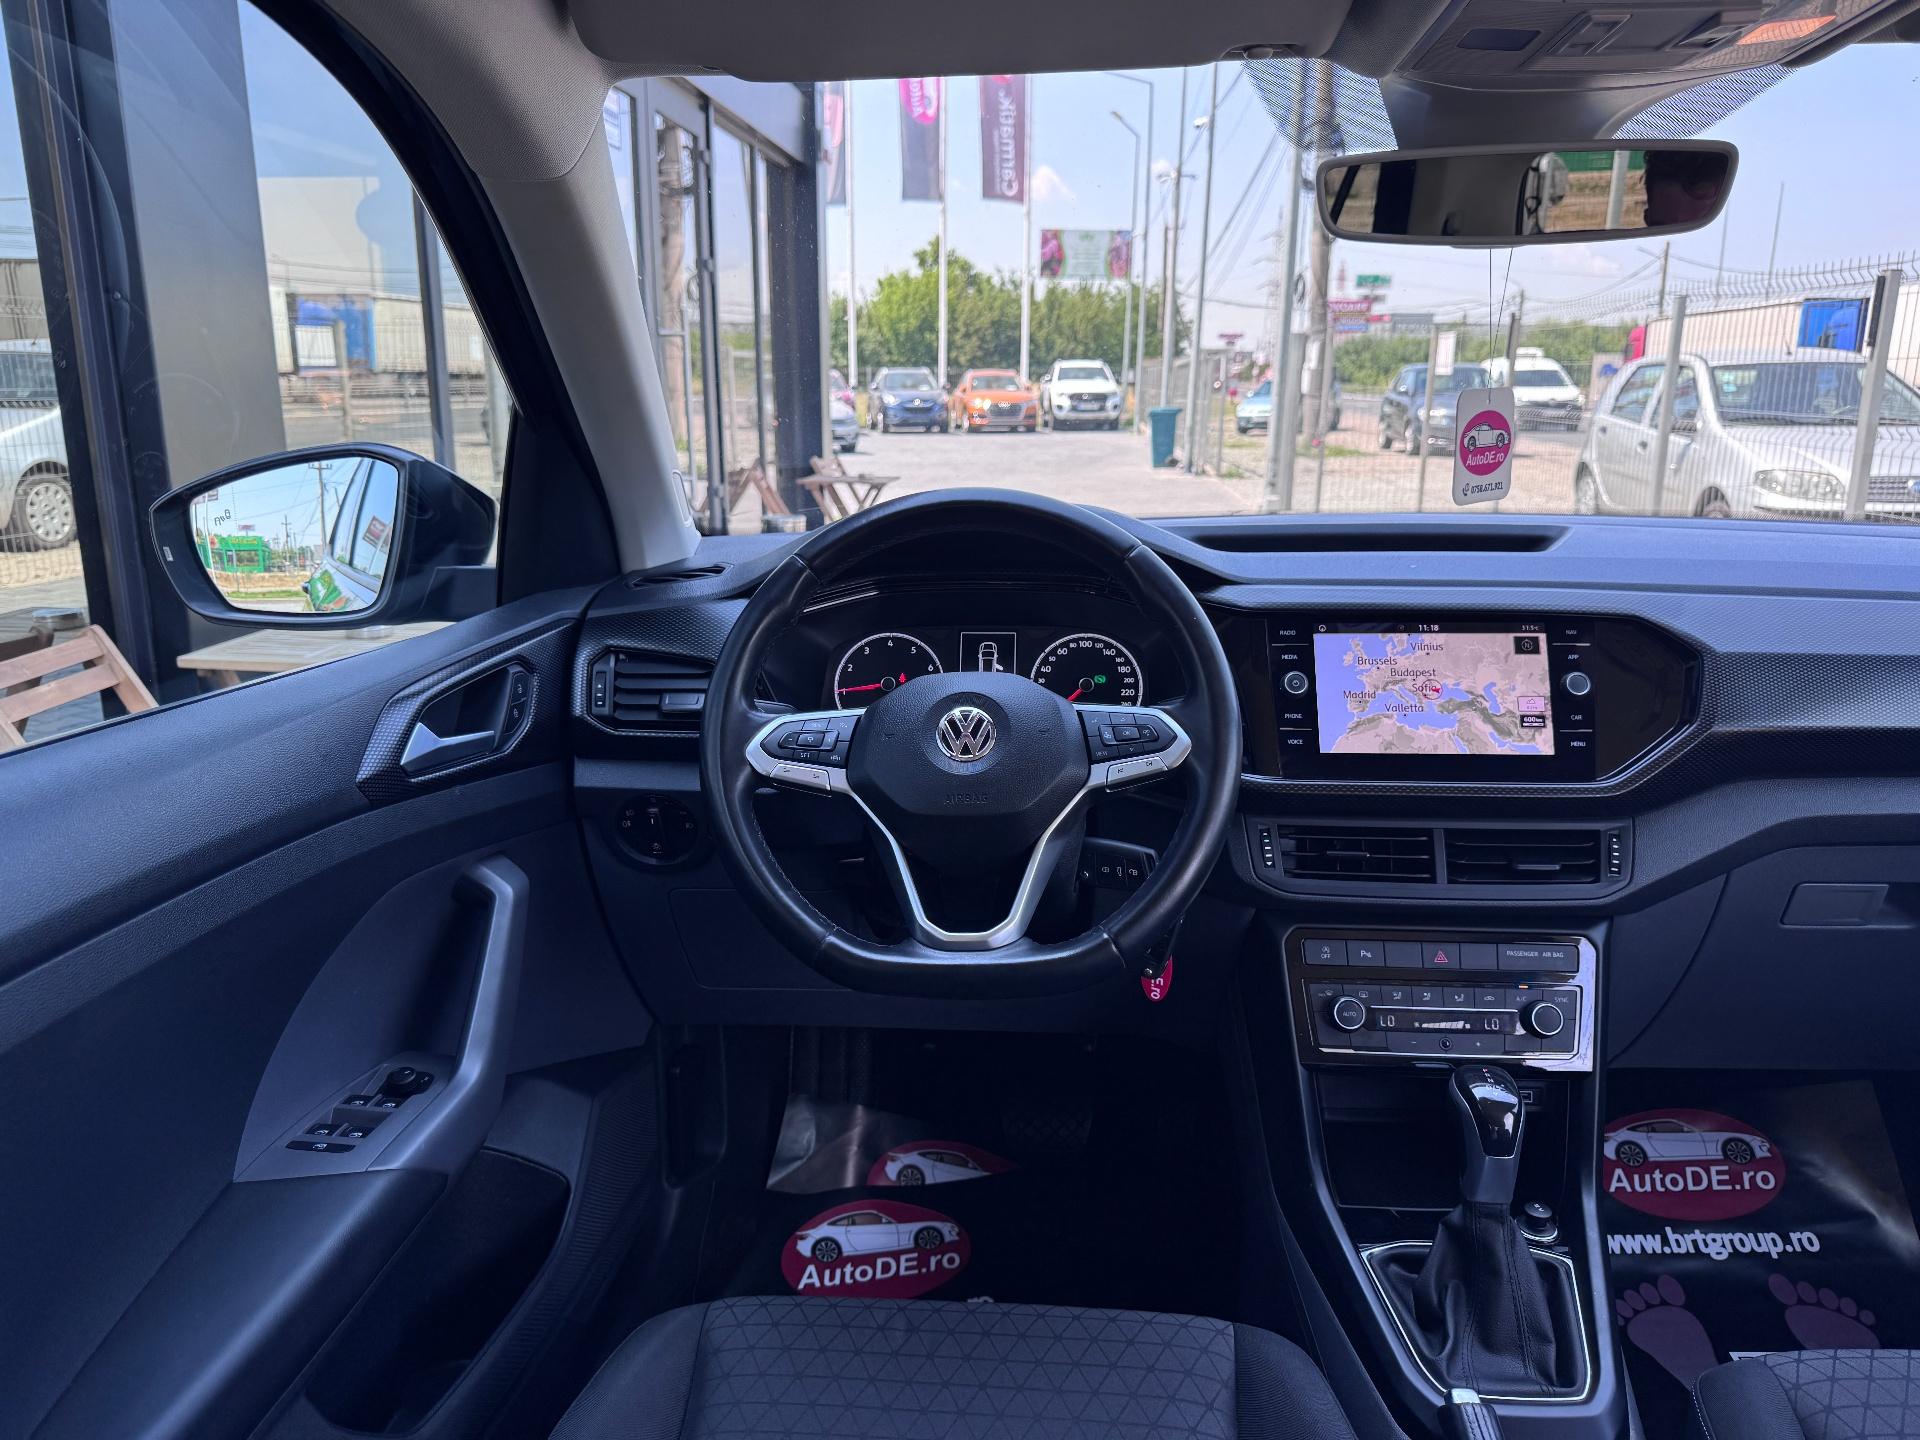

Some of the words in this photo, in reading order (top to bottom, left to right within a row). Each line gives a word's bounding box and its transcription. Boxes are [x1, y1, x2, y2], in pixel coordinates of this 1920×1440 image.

[1466, 451, 1505, 466] AutoDE.ro
[1418, 624, 1440, 632] 11:18
[887, 639, 894, 647] 4
[1079, 640, 1093, 648] 100
[1410, 642, 1444, 651] Vilnius
[864, 646, 870, 655] 3
[910, 646, 917, 654] 5
[1057, 647, 1068, 655] 60
[1102, 648, 1116, 656] 140
[1357, 656, 1398, 666] Brussels
[847, 664, 853, 672] 2
[927, 664, 934, 672] 6
[1040, 665, 1051, 673] 40
[1118, 665, 1131, 673] 180
[1390, 668, 1436, 679] Budapest
[1411, 683, 1437, 693] Sofia
[1343, 690, 1377, 699] Madrid
[1384, 703, 1424, 713] Valletta
[1609, 1165, 1776, 1193] AutoDE.ro
[1607, 1226, 1820, 1261] www.brtgroup.ro
[797, 1252, 961, 1291] AutoDE.ro
